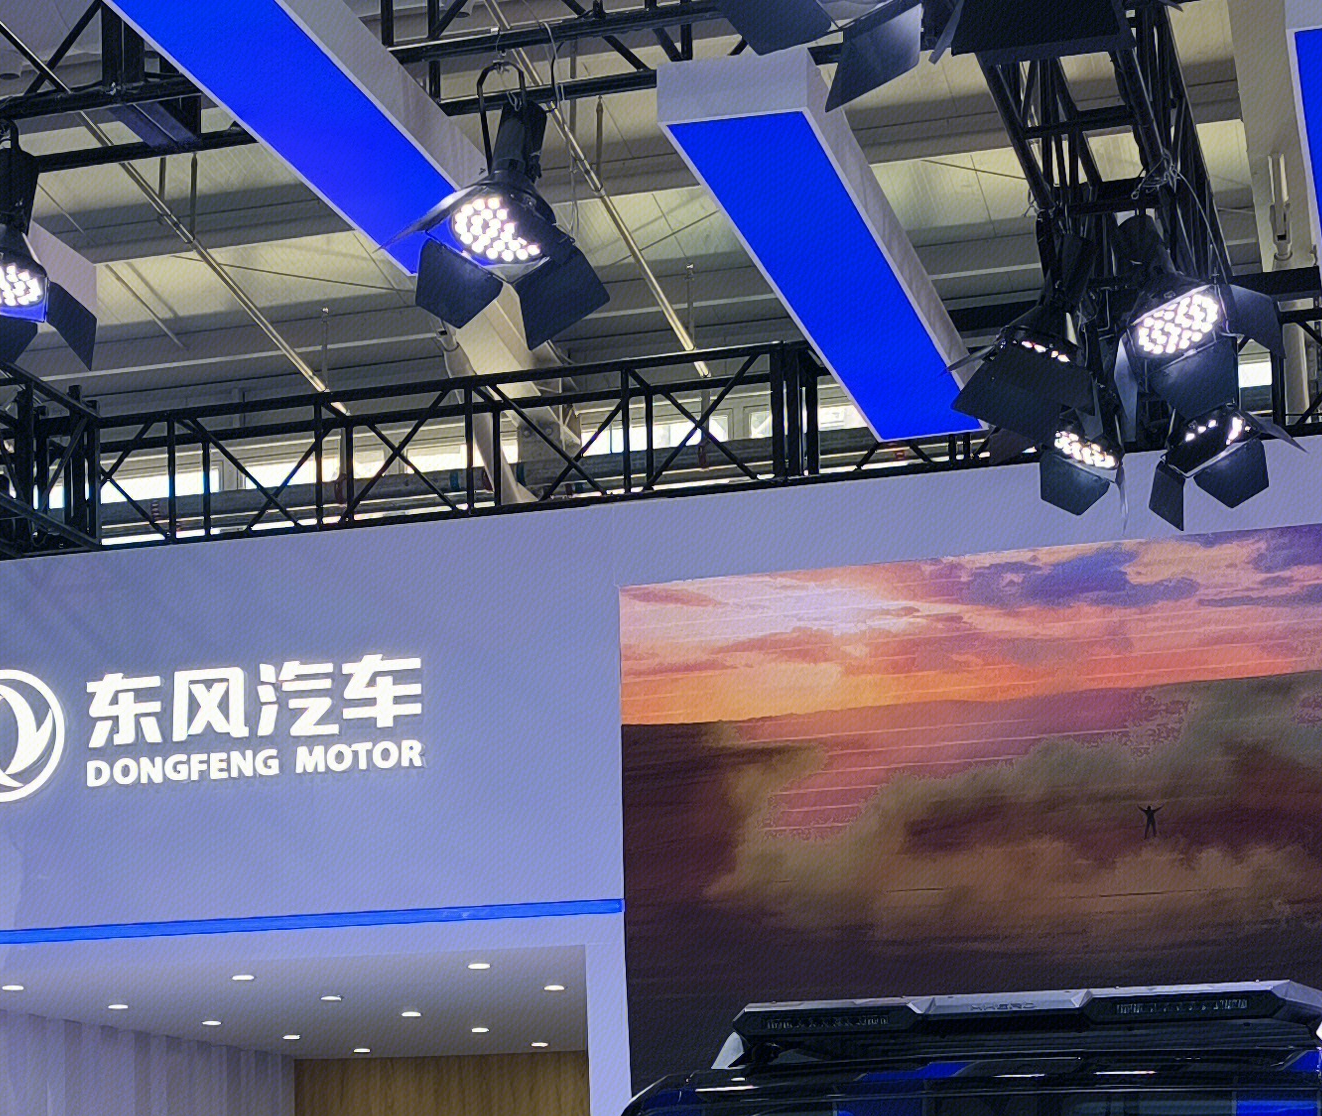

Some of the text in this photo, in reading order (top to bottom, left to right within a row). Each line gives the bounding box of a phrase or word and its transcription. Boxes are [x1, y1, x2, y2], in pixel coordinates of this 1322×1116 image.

[85, 653, 423, 748] 东风汽车
[86, 740, 425, 787] DONGFENG MOTOR
